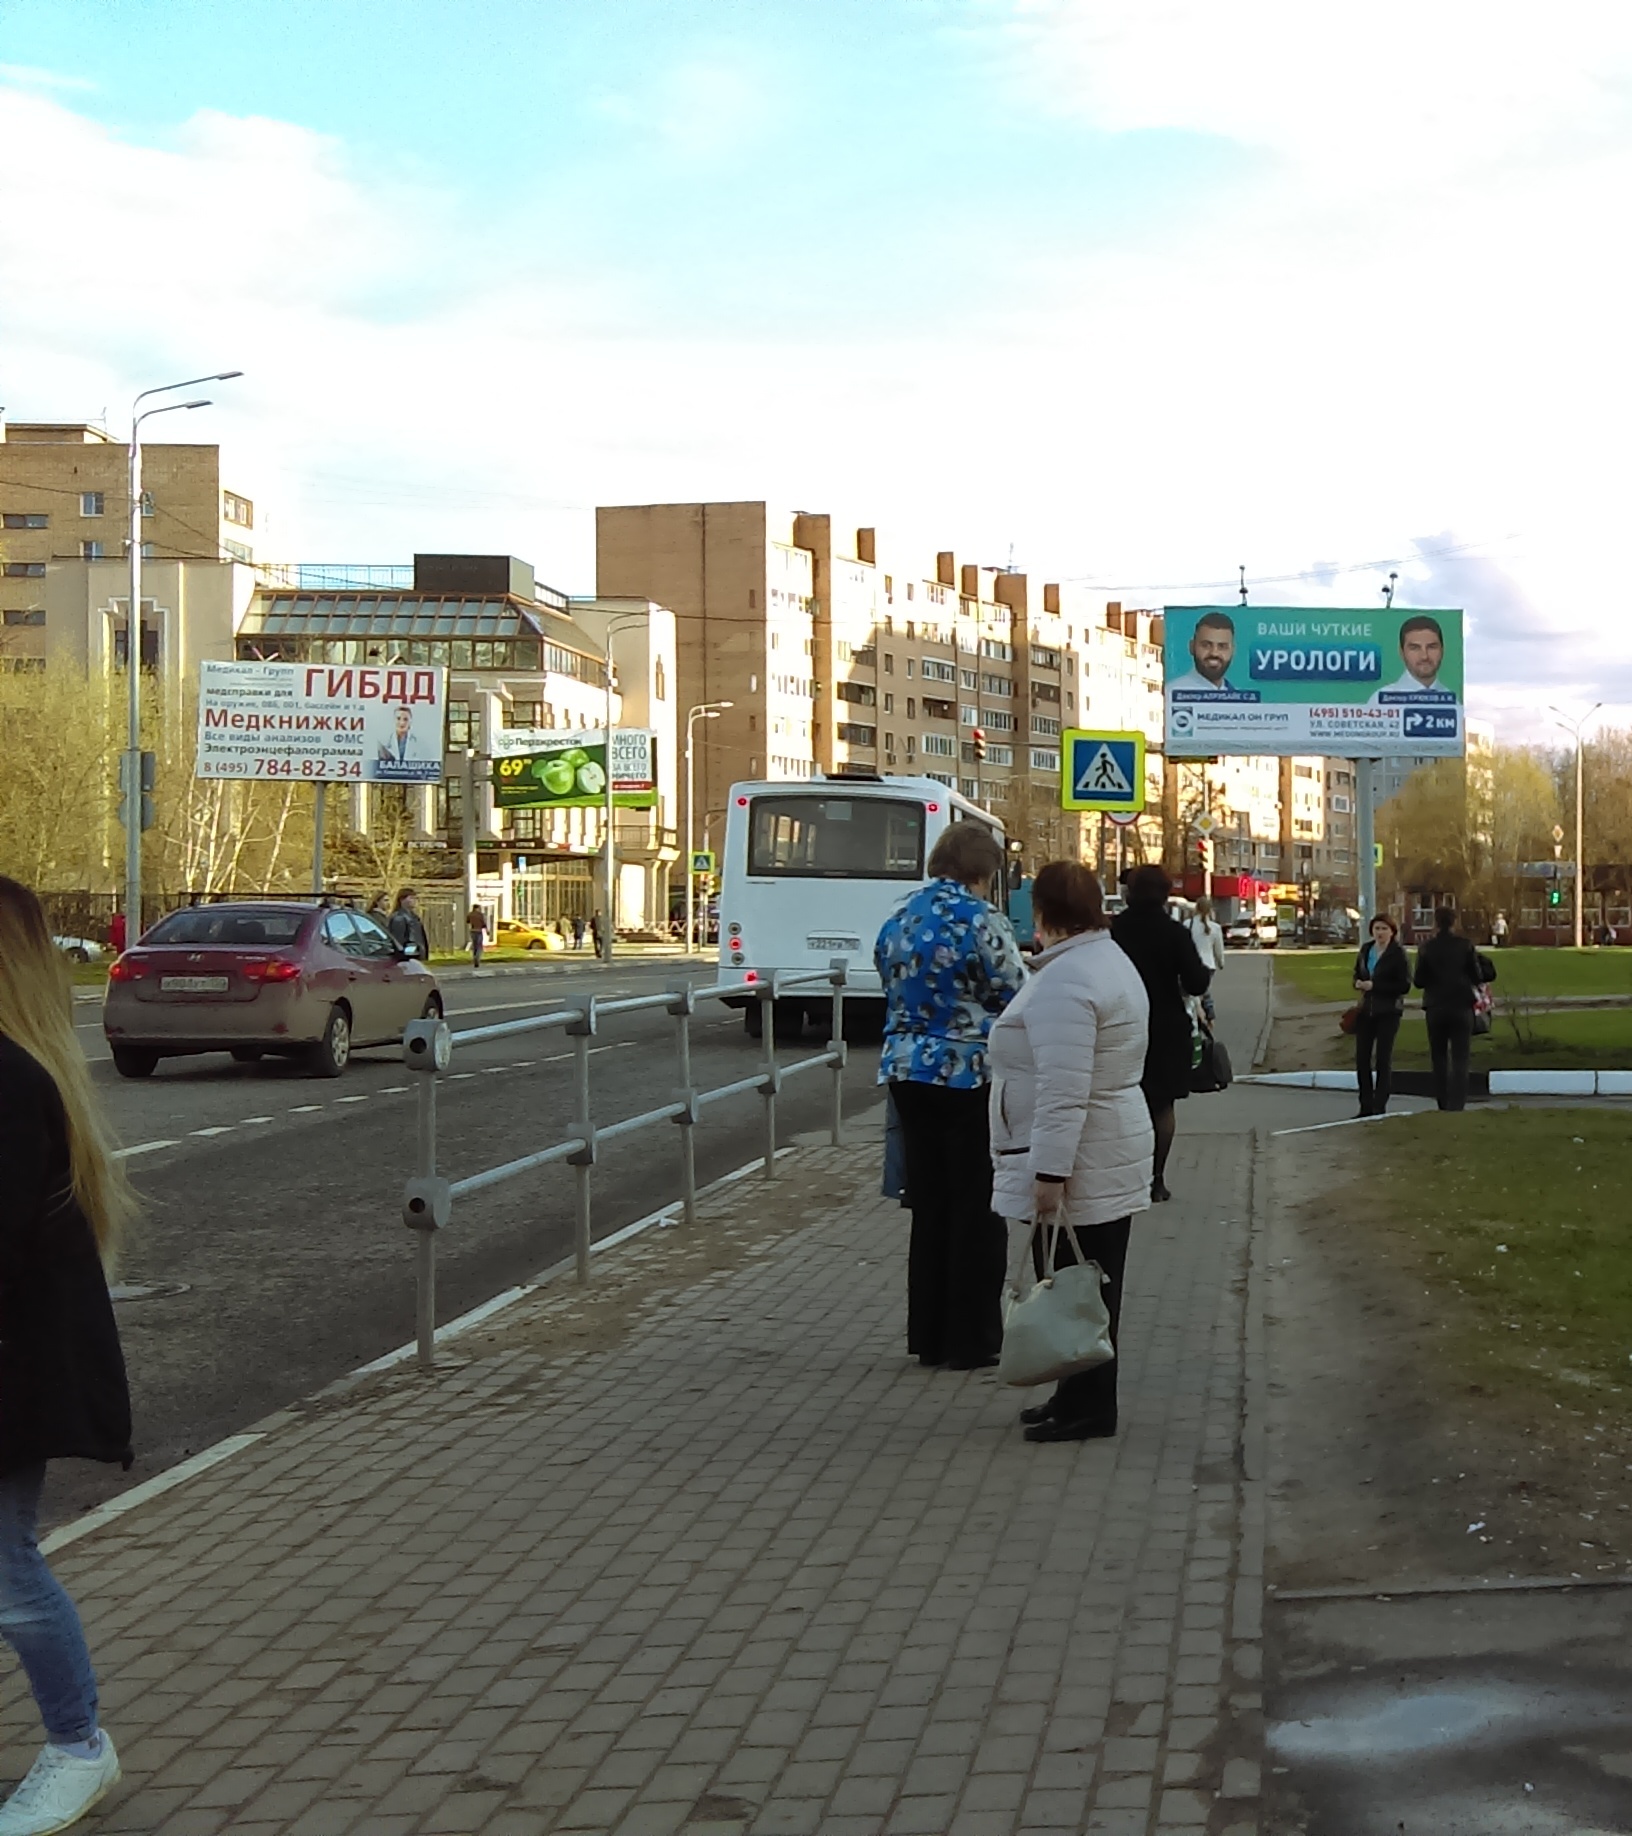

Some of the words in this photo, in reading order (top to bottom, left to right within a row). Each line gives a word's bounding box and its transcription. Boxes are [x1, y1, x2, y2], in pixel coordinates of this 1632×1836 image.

[1258, 622, 1306, 636] ВАШИ
[1311, 622, 1372, 637] ЧУТКИЕ
[1256, 649, 1375, 672] УРОЛОГИ
[305, 668, 436, 705] ГИБДД
[274, 690, 293, 698] для
[1197, 713, 1245, 721] МЕДИКАЛ
[1248, 713, 1262, 721] ОН
[1264, 713, 1289, 721] ГРУП
[1309, 707, 1339, 718] (495)
[1342, 708, 1400, 718] 510-43-01
[205, 708, 365, 732] Медкнижки
[1425, 716, 1434, 728] 2
[205, 731, 225, 741] Все
[229, 733, 260, 742] виды
[264, 734, 321, 743] анализов
[333, 733, 364, 744] ФМС
[204, 743, 363, 757] Электроэнцефалограмма
[204, 762, 212, 772] 8
[215, 762, 249, 774] (495)
[254, 759, 362, 777] 784-82-34
[379, 760, 441, 770] БАЛАШИХА
[500, 759, 523, 776] 69
